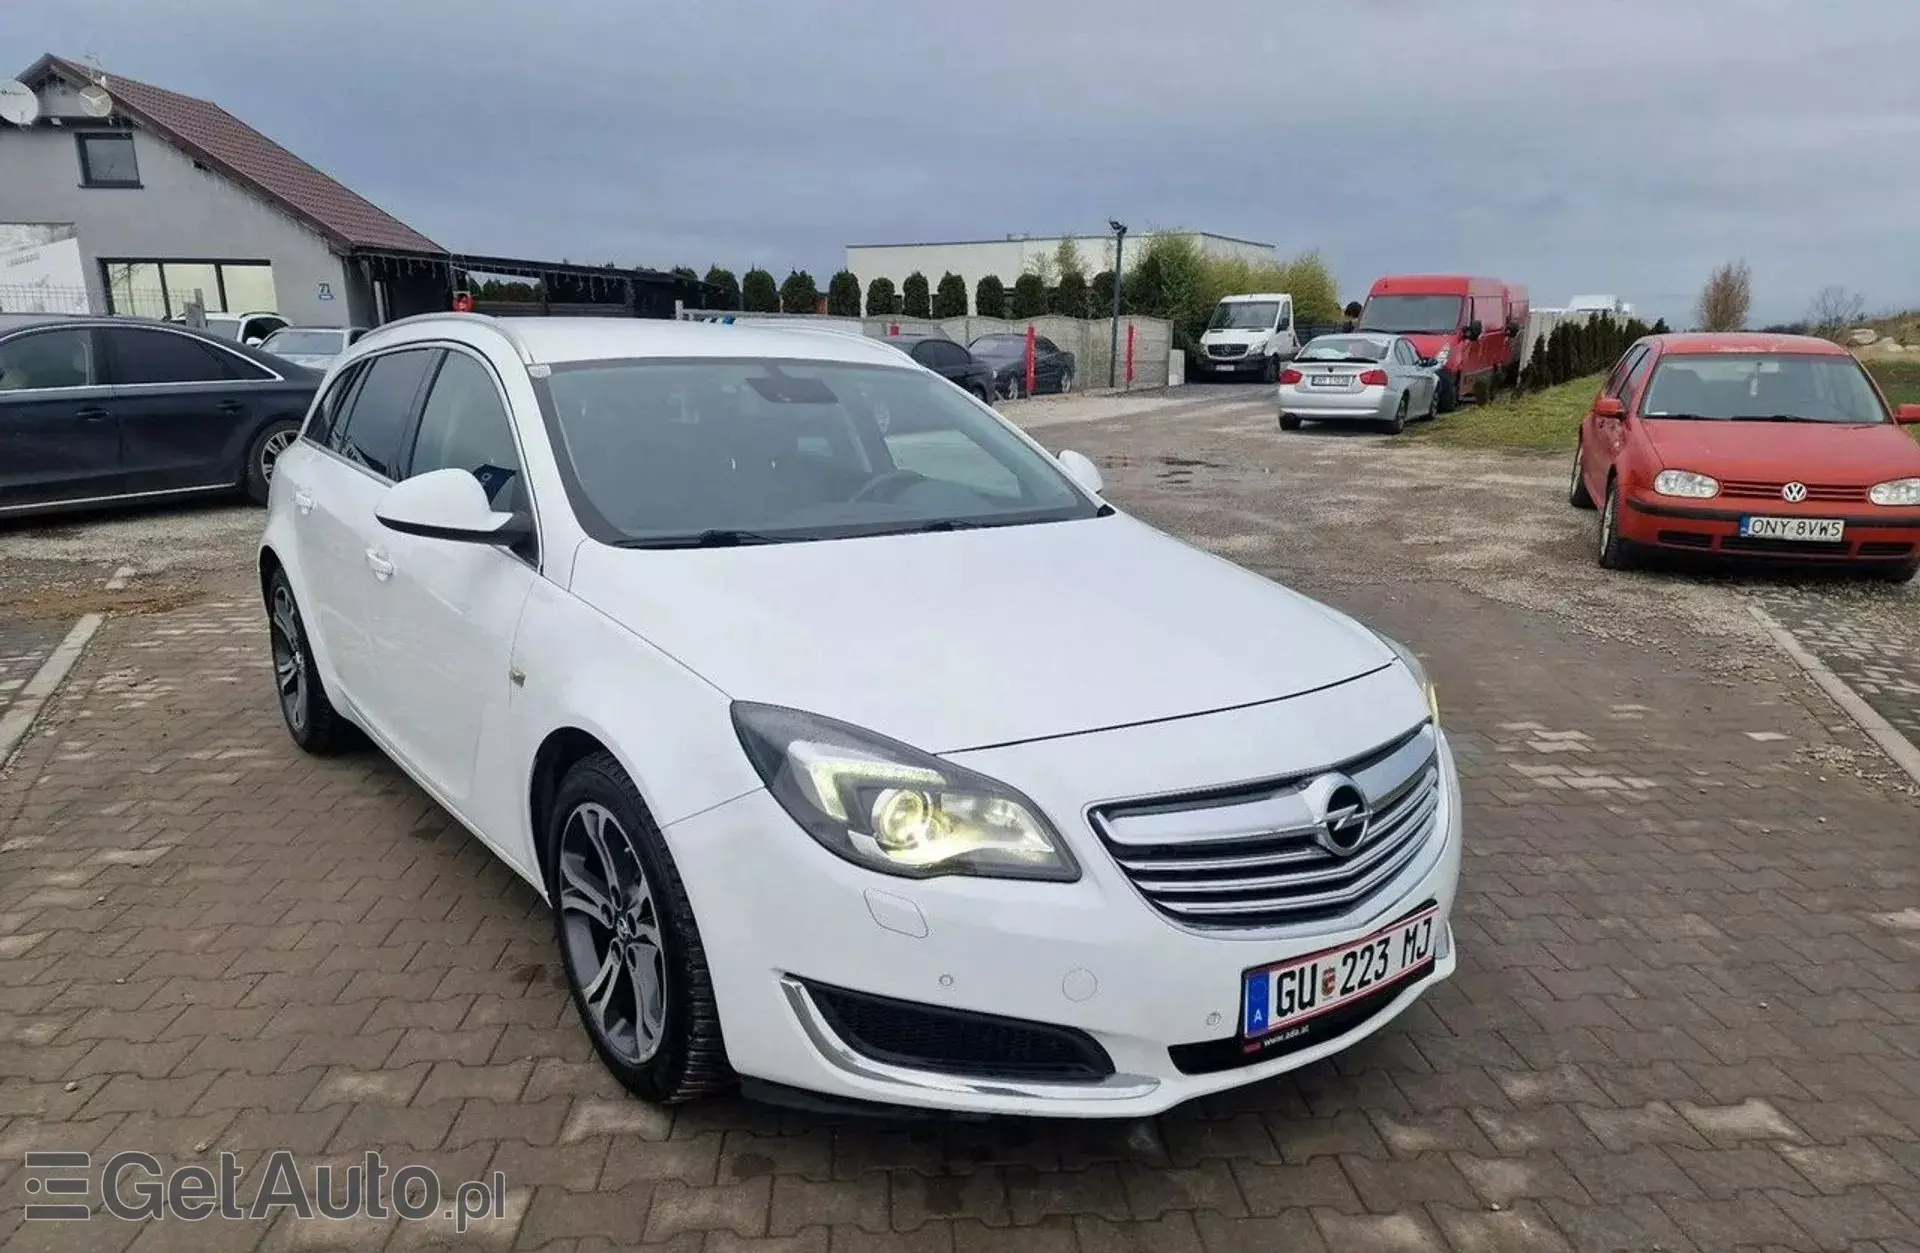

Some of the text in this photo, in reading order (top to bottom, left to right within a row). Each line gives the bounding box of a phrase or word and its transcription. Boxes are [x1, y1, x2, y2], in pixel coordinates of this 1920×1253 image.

[1752, 519, 1841, 538] ONY 8VW5
[1276, 917, 1433, 1018] GU 223 MJ
[1254, 1009, 1263, 1024] A
